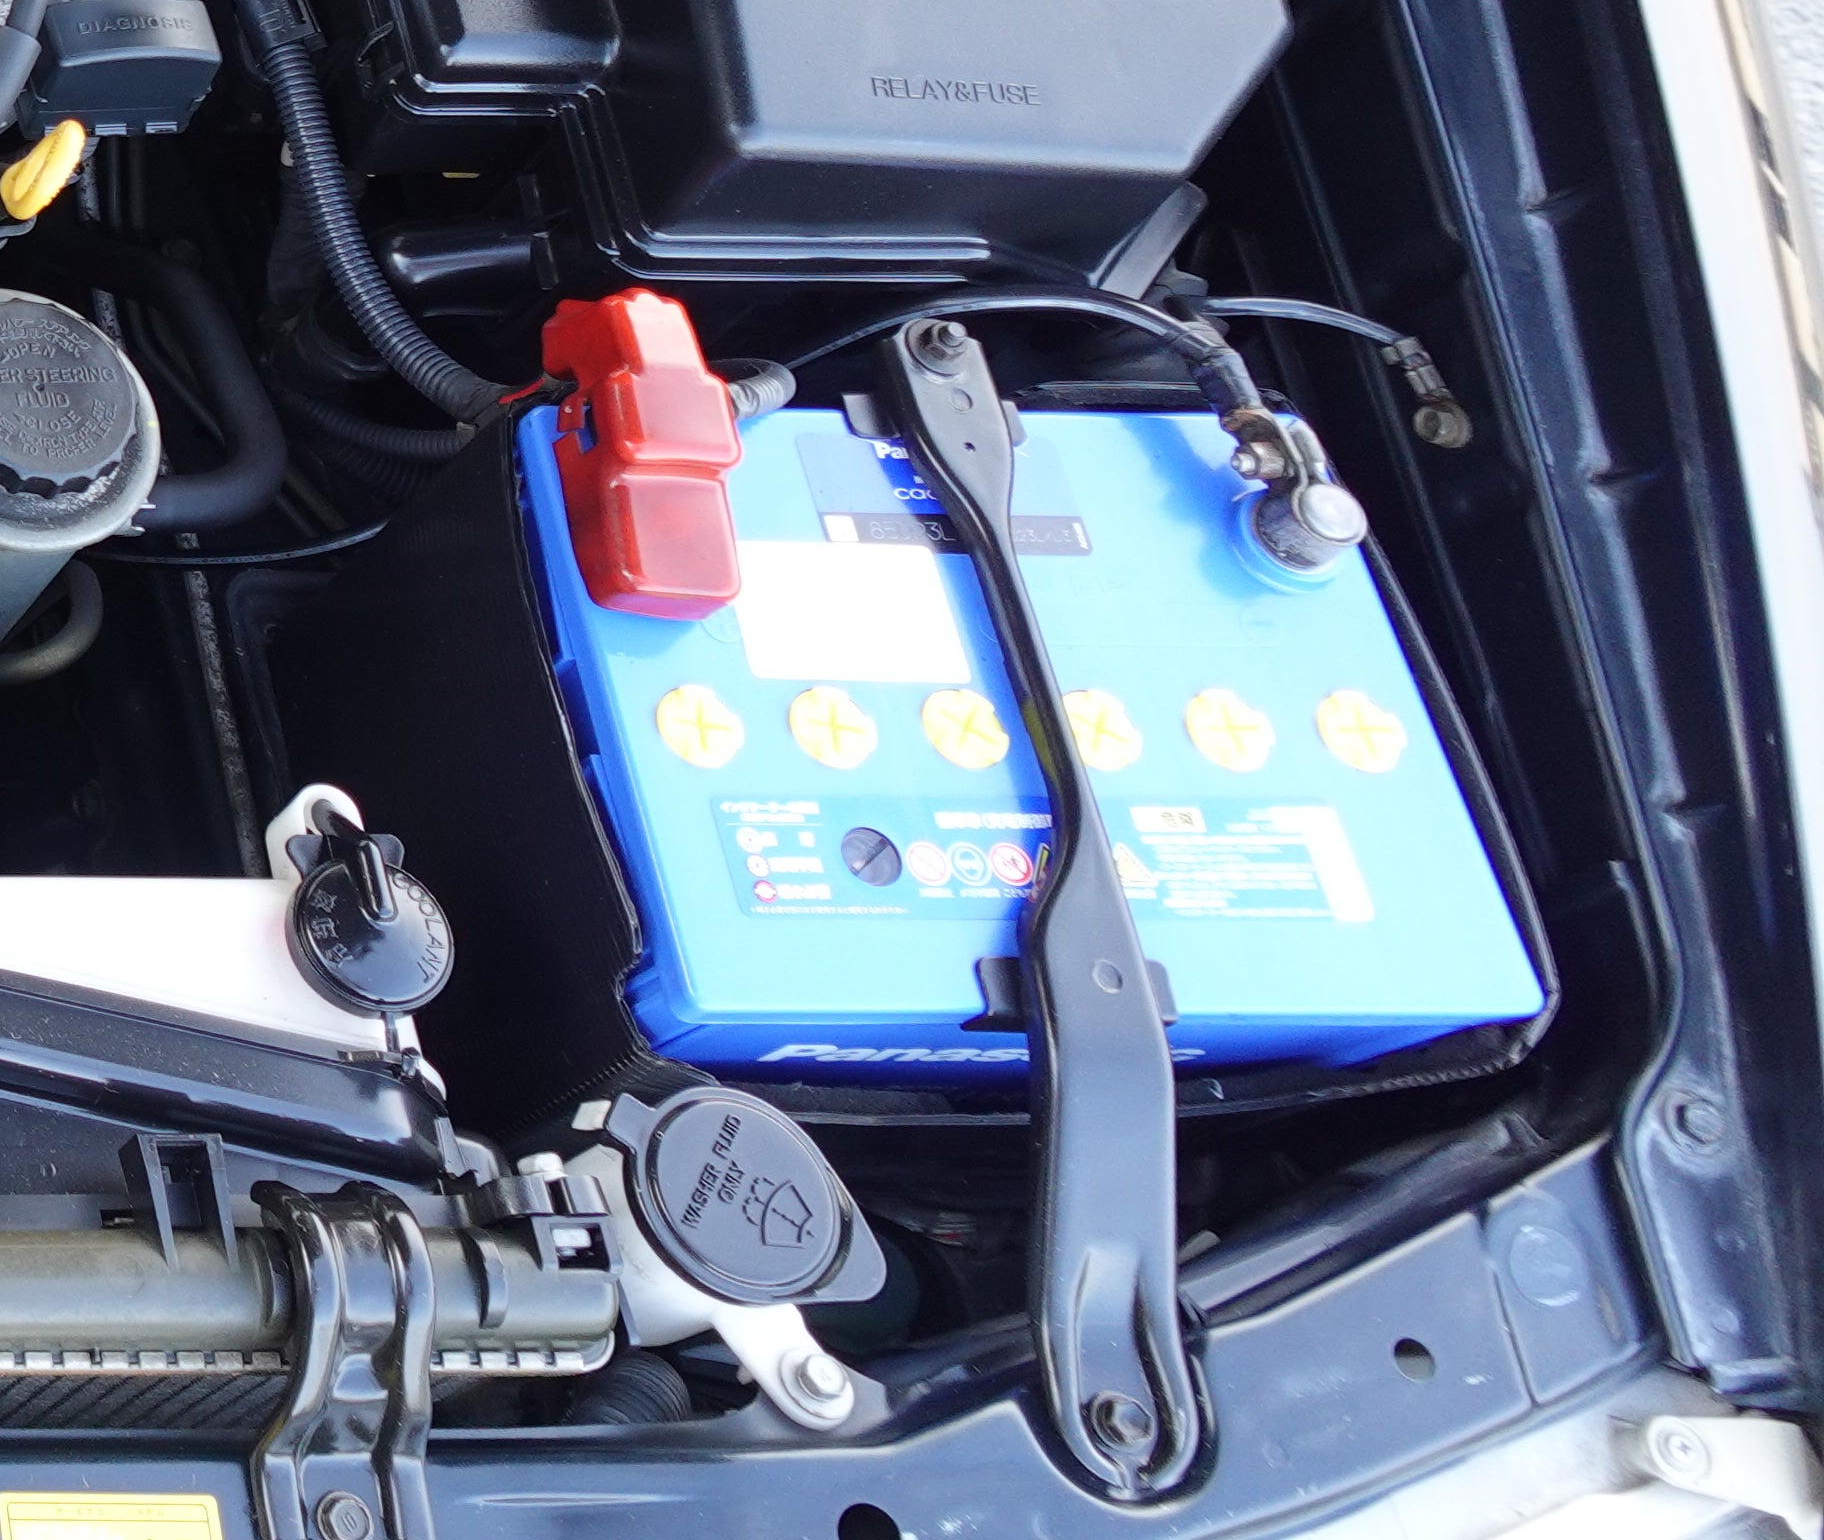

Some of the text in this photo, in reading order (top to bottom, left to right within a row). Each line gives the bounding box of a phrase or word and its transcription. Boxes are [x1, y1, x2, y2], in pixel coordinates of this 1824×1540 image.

[78, 15, 193, 36] DIAGNOSIS
[870, 74, 1043, 107] RELAY&FUSE
[24, 366, 116, 384] STEERING
[15, 391, 71, 409] FLUID
[24, 409, 83, 432] CLOSE
[21, 441, 40, 457] TO
[392, 871, 446, 984] COOLANT
[757, 1044, 1206, 1063] Panasc
[679, 1114, 742, 1230] WASHER FLUID
[717, 1161, 747, 1205] ONLY
